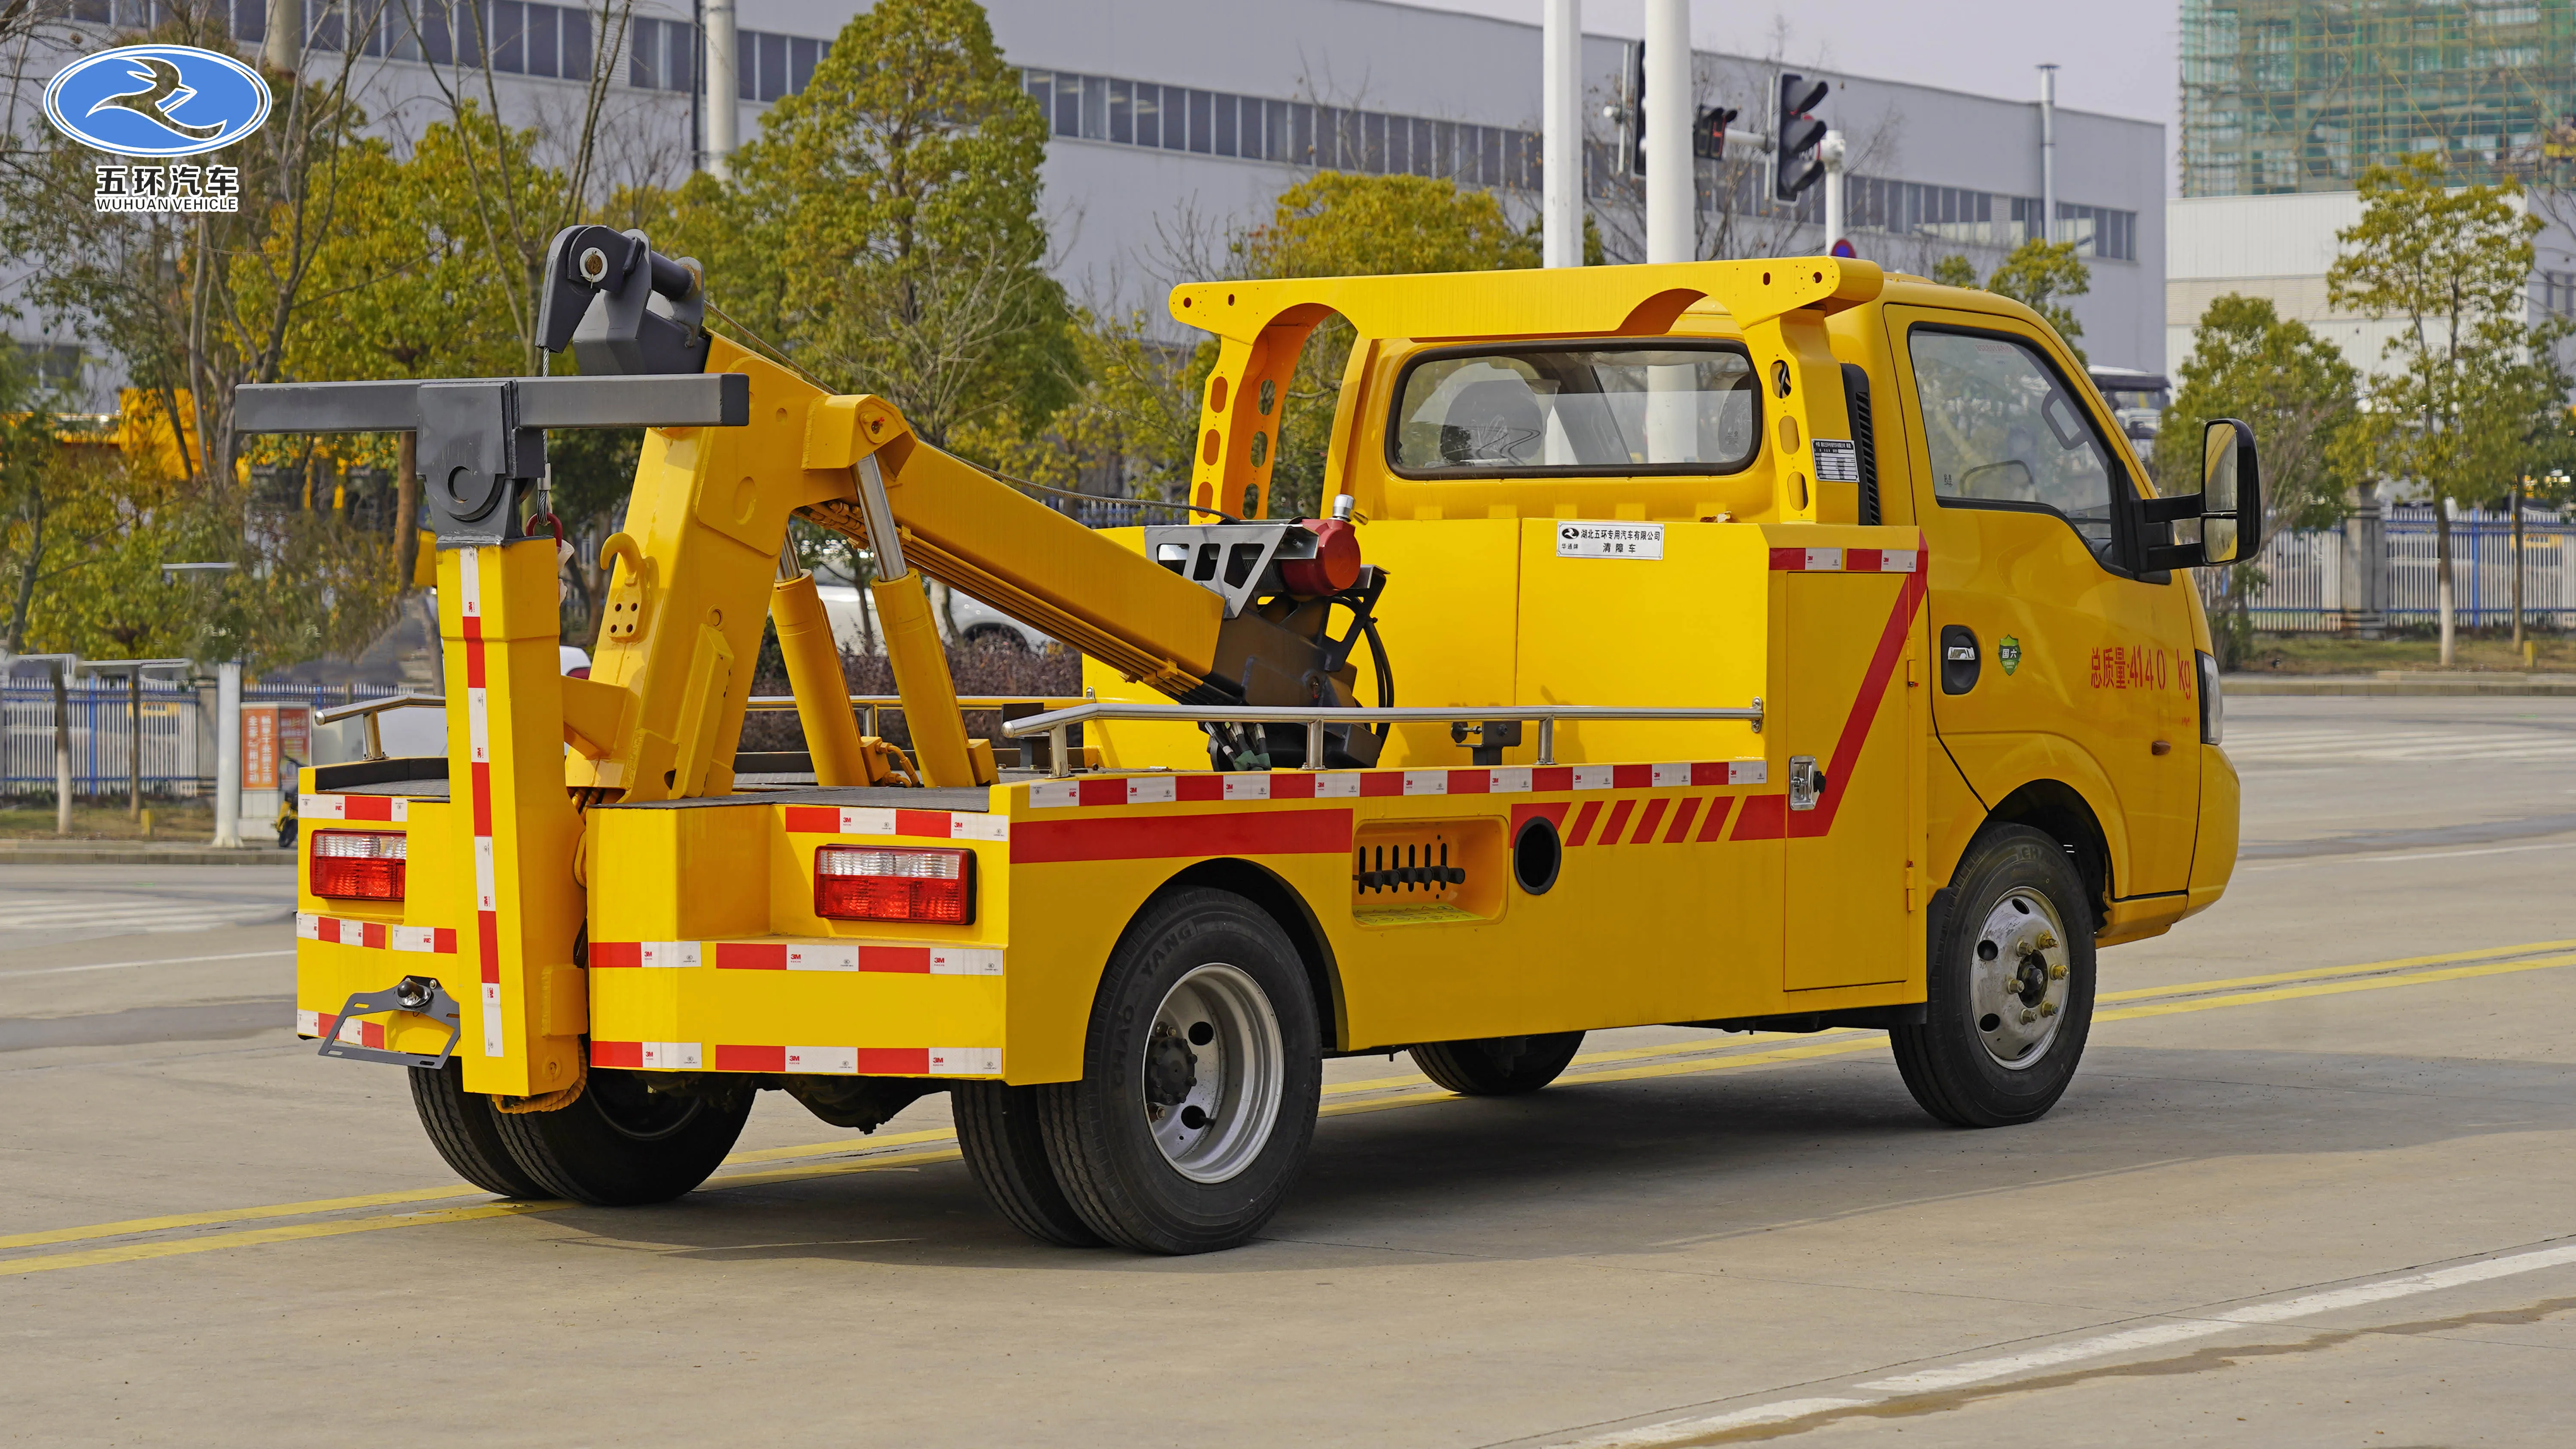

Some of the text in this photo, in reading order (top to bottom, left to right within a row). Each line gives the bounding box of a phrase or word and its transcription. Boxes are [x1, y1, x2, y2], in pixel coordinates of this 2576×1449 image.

[1581, 529, 1660, 541] 湖北五环专用汽车有限公司
[1603, 543, 1636, 553] 清障车
[2002, 648, 2017, 659] 国六
[2176, 649, 2191, 700] kg
[484, 896, 488, 907] 3M
[1140, 925, 1195, 978] YANG
